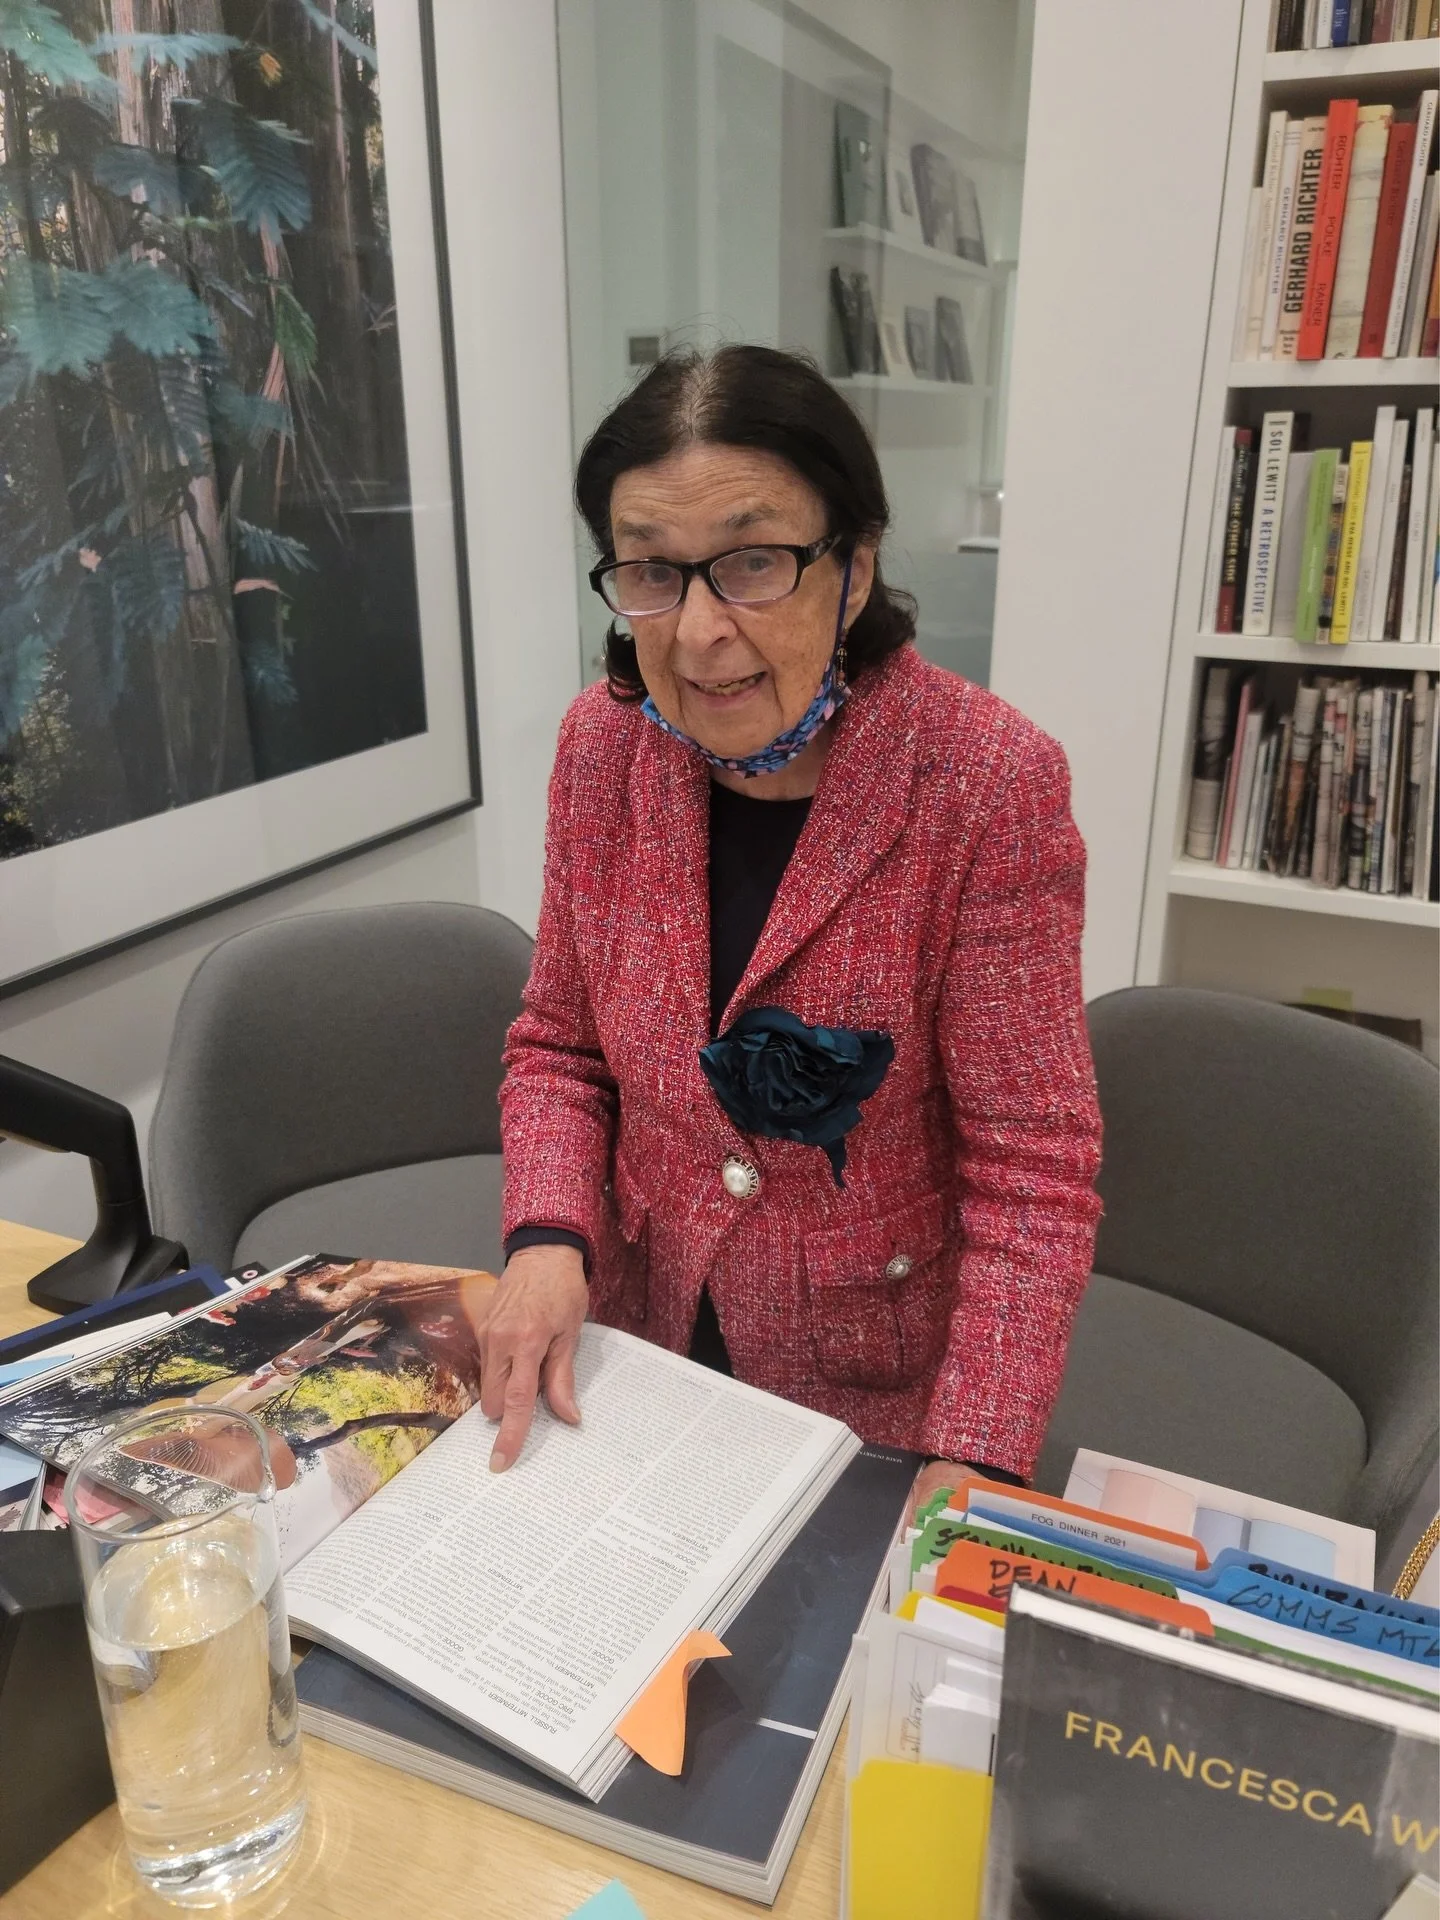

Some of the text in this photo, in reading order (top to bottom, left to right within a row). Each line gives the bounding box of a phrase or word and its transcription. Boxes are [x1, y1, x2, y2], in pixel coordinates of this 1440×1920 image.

[1331, 134, 1347, 190] RICHTER
[1294, 146, 1324, 225] RICHTER
[1270, 186, 1292, 294] GERHARD RICHTER
[1322, 215, 1335, 257] POLKE
[1282, 229, 1313, 314] GERHARD
[1312, 282, 1326, 327] RAINER
[1268, 430, 1282, 454] SOL
[1263, 458, 1279, 502] LEWITT
[1227, 519, 1240, 556] OTHER
[1224, 557, 1236, 583] SIDE
[1252, 521, 1271, 614] RETROSPECTIVE
[1031, 1513, 1126, 1548] FOG DINNER 2021
[990, 1558, 1076, 1594] DEAN
[1228, 1585, 1359, 1634] COMMS
[441, 1636, 465, 1652] GOODE
[591, 1649, 615, 1664] GOODE
[554, 1663, 595, 1688] MITTERMEIER
[486, 1690, 528, 1717] MITTERMEIER
[534, 1689, 559, 1706] GOODE
[557, 1702, 574, 1714] ERIC
[528, 1714, 557, 1734] RUSSELL
[1064, 1710, 1372, 1837] FRANCESCA
